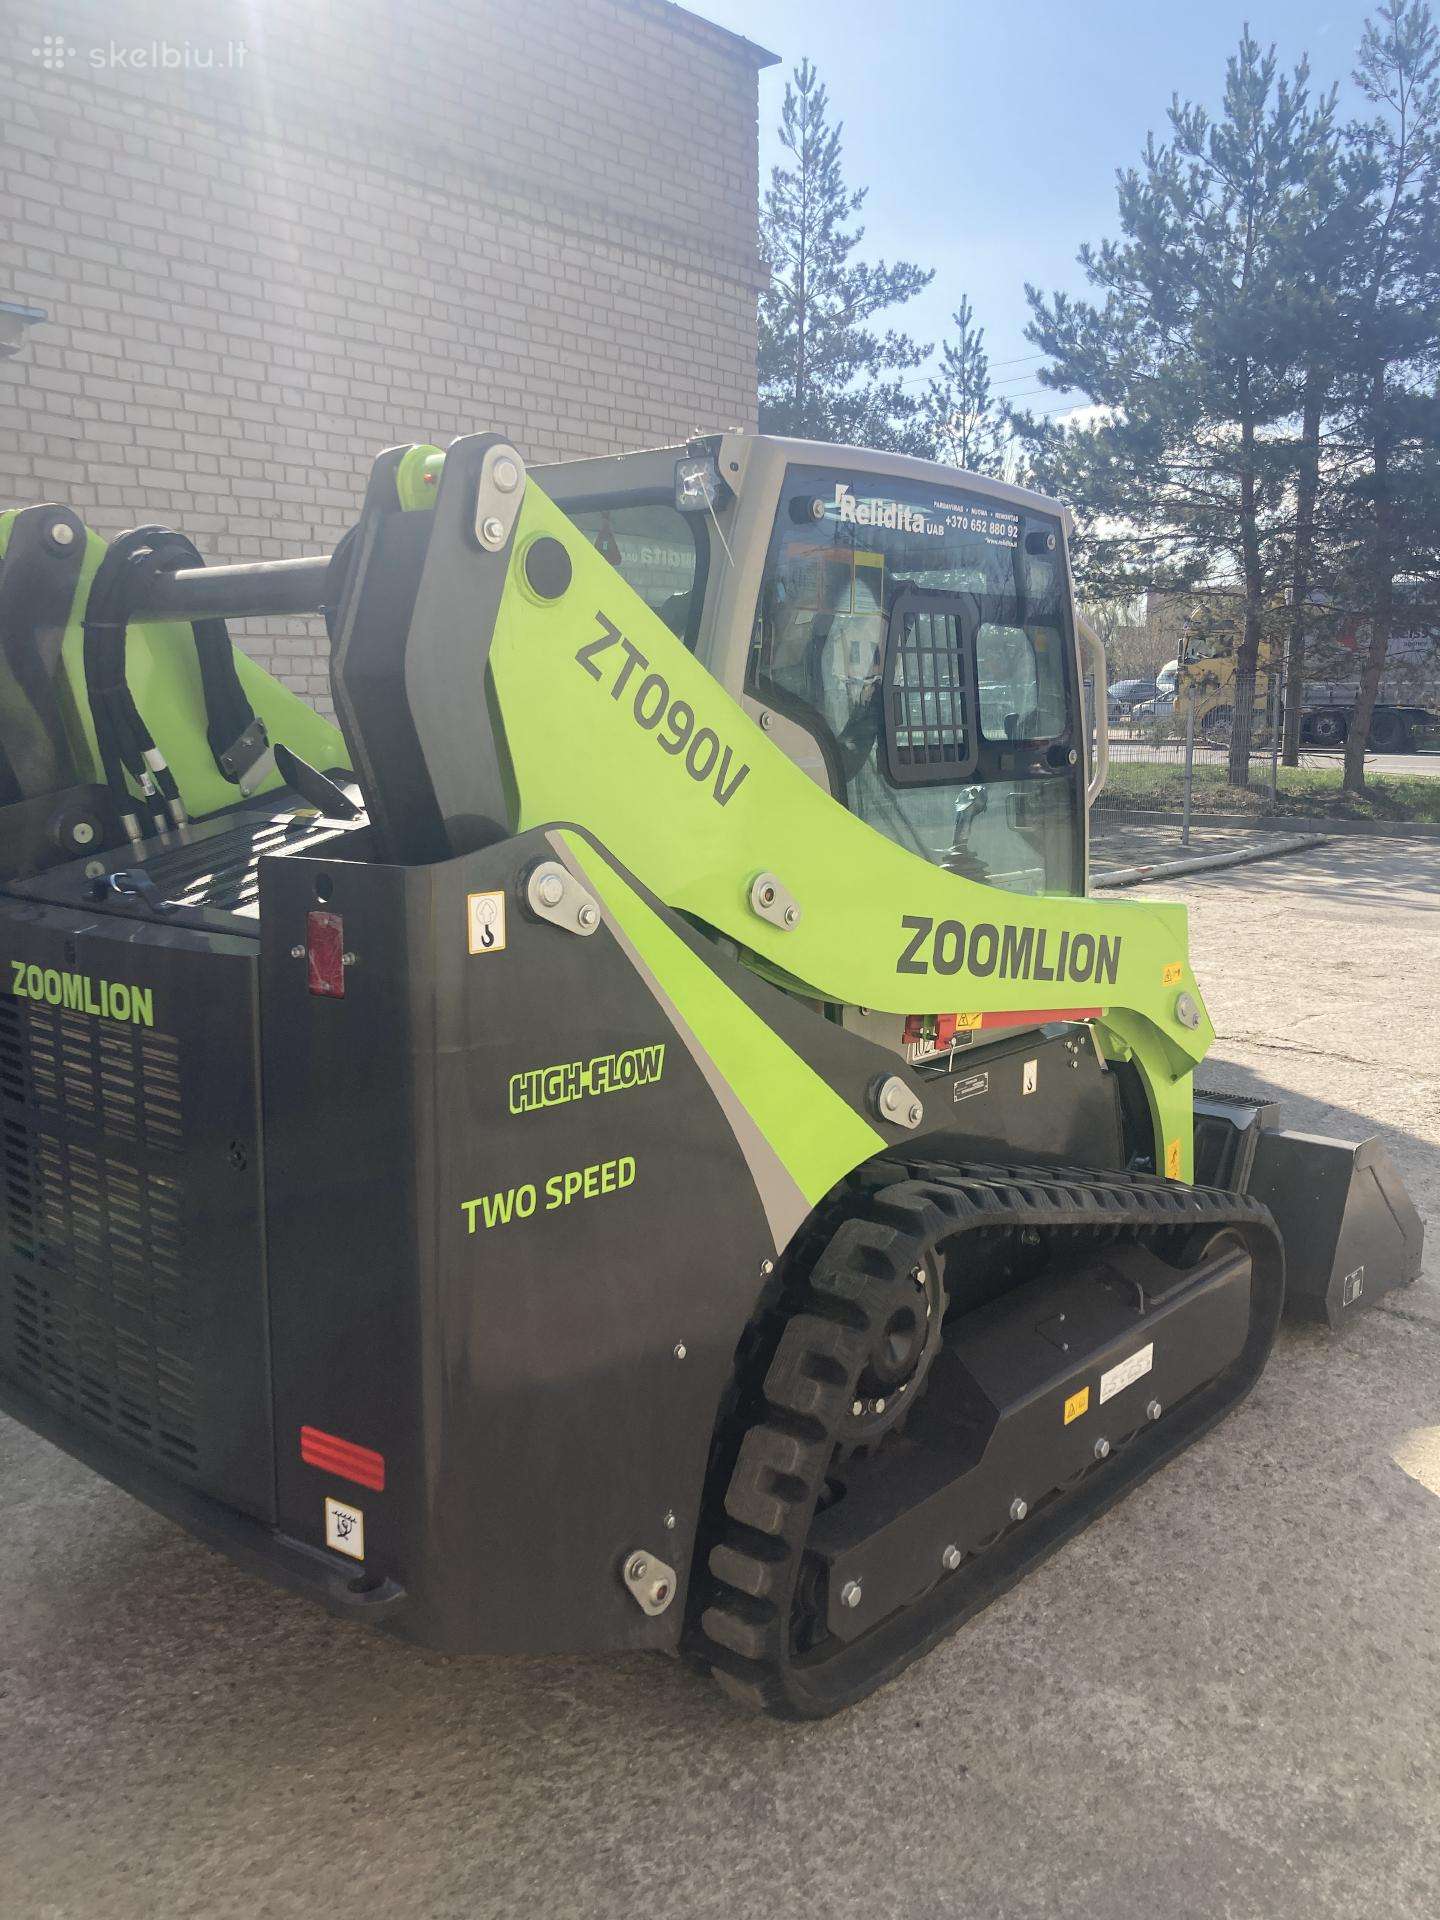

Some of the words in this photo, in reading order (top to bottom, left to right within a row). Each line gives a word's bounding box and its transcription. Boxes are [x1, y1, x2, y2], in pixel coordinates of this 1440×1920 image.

[926, 523, 944, 536] UAB
[945, 515, 968, 530] +370
[970, 518, 987, 533] 652
[989, 522, 1005, 536] 880
[1007, 525, 1018, 538] 92
[574, 610, 751, 807] ZT090V
[896, 914, 1122, 985] ZOOMLION
[11, 960, 154, 1027] ZOOMLION
[460, 1184, 537, 1234] TWO
[545, 1156, 636, 1210] SPEED
